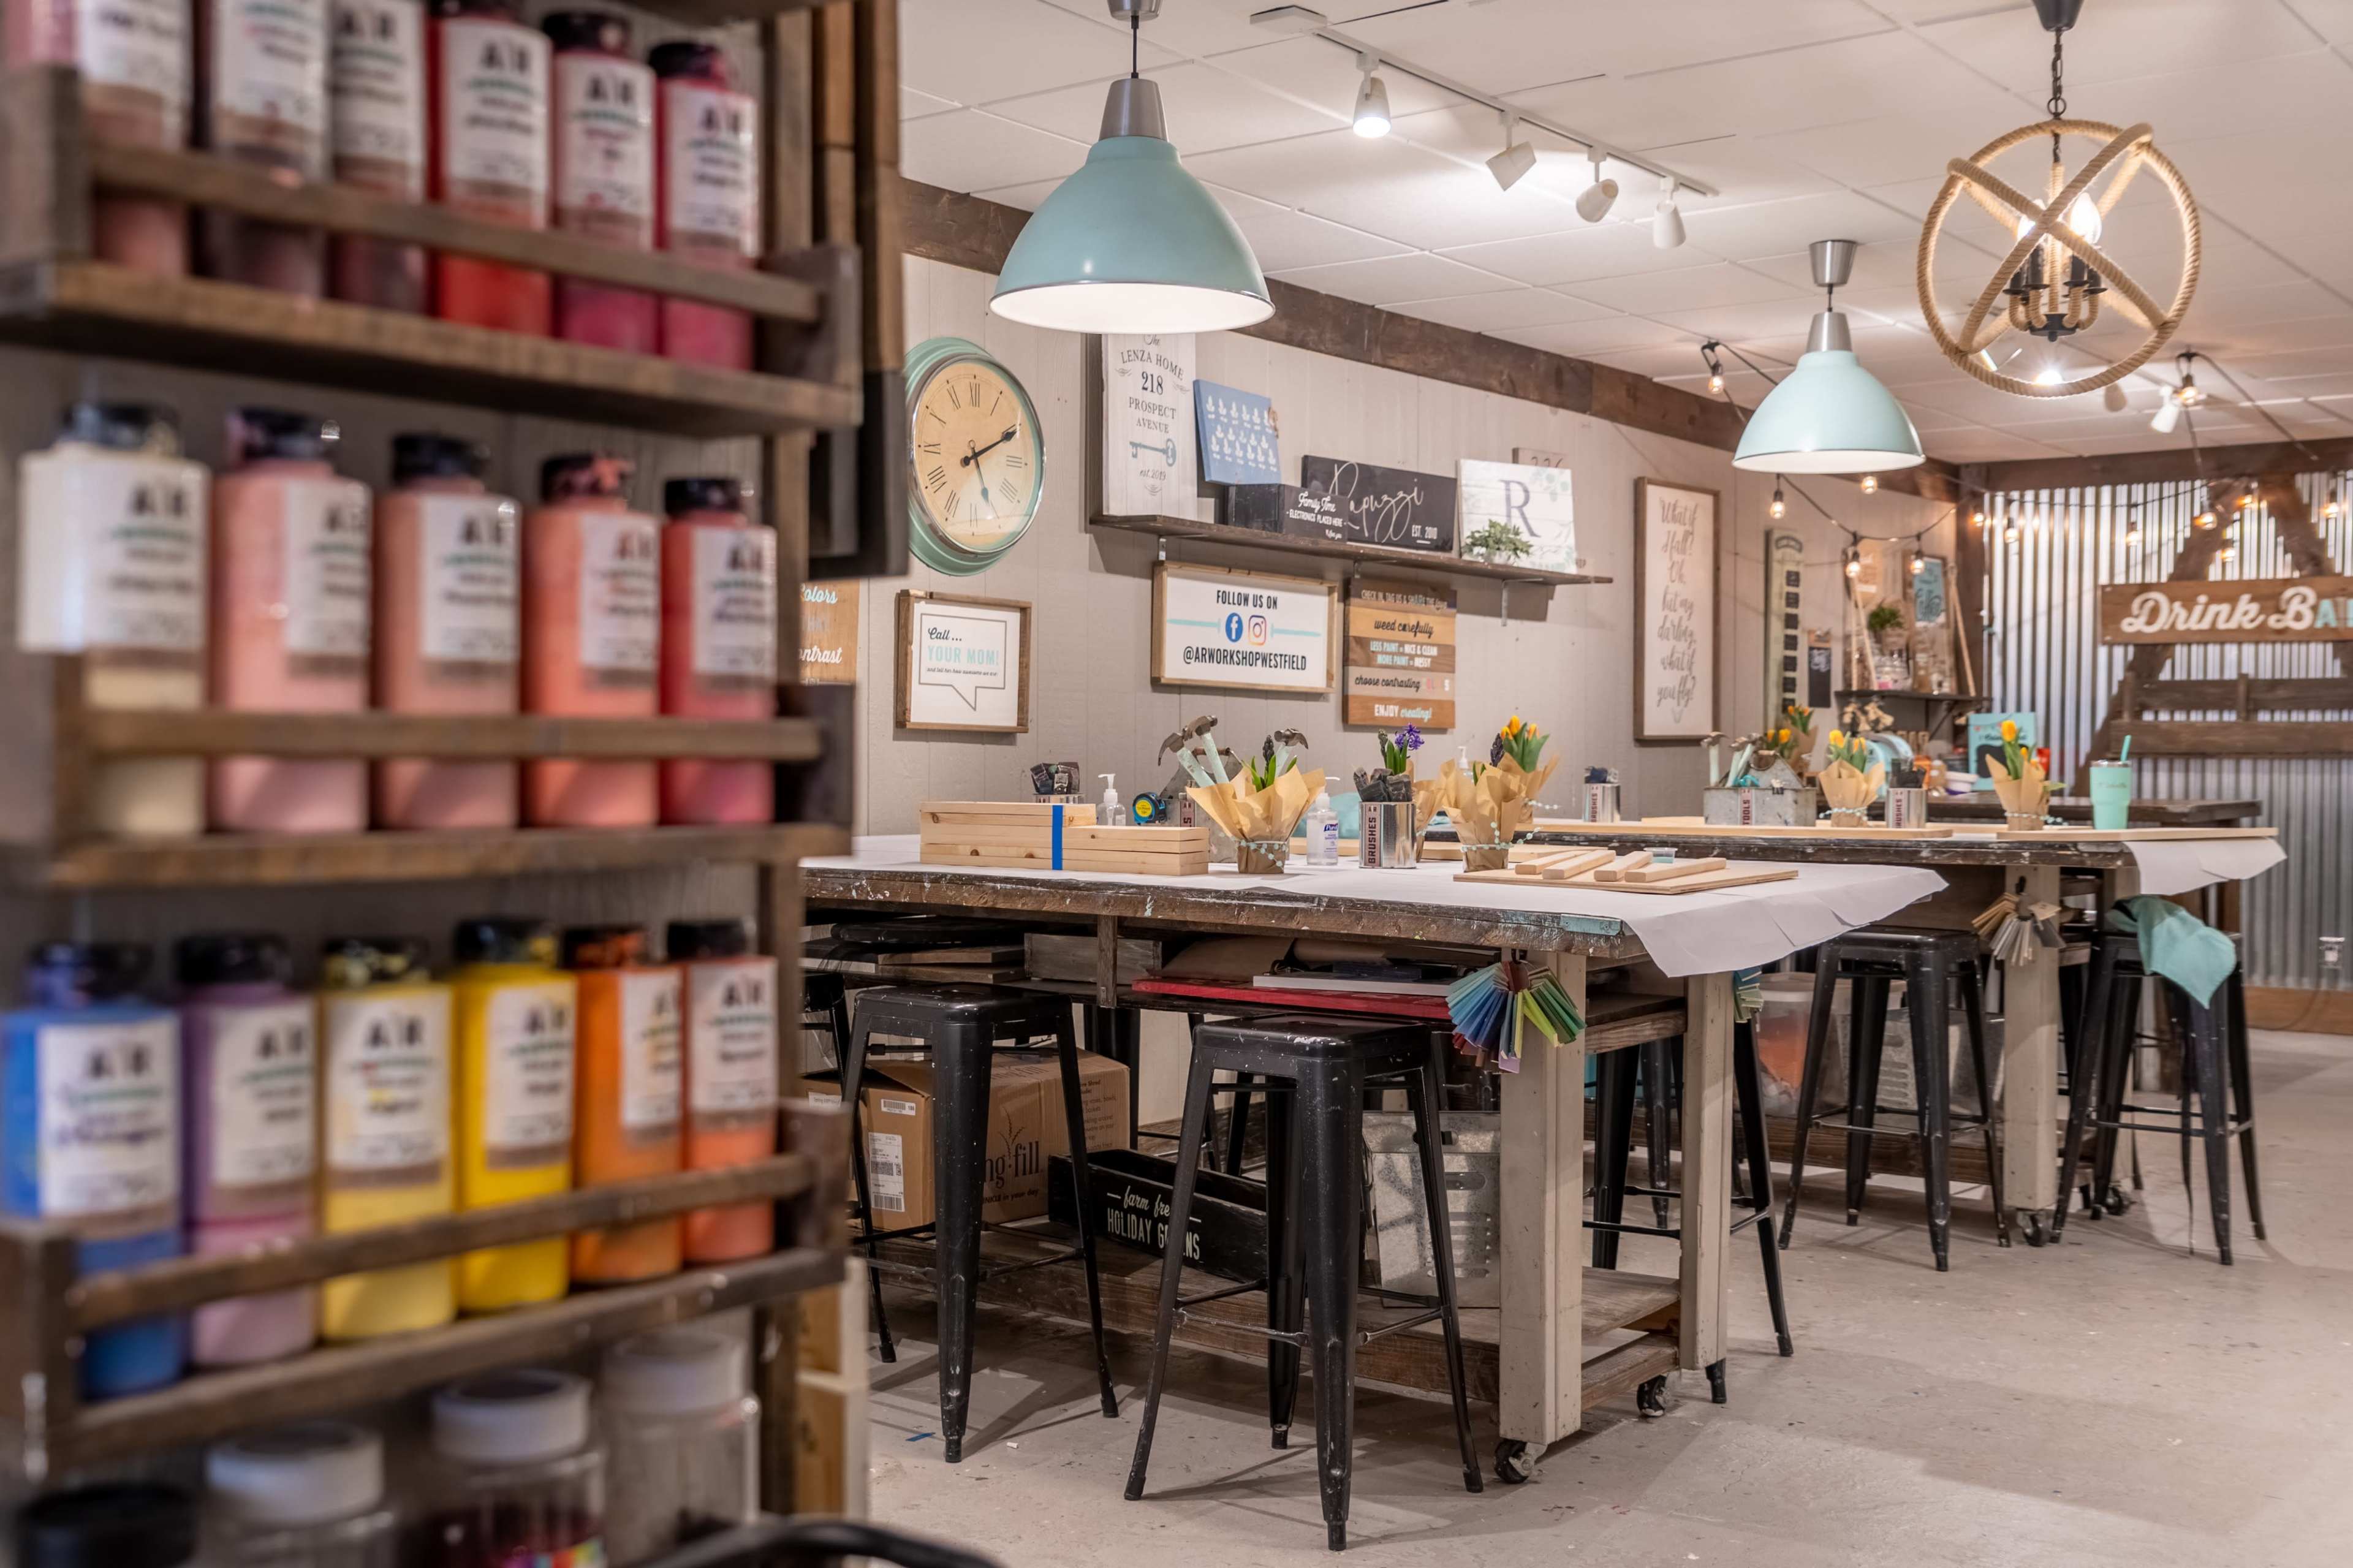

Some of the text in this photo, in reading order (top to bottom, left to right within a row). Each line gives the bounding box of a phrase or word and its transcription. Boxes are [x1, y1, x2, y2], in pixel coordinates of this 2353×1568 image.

[1121, 349, 1184, 381] LENZA HOME
[1142, 371, 1163, 395] 218
[1129, 396, 1176, 419] PROSPECT
[1136, 417, 1170, 434] AVENUE
[1298, 491, 1336, 513] Family Time
[1497, 479, 1542, 539] R
[1659, 497, 1688, 526] What
[1289, 509, 1343, 527] ELECTRONICS PLACED HERE
[1216, 589, 1278, 610] FOLLOW US ON
[1361, 589, 1376, 599] CHECK
[1385, 593, 1395, 603] TAG
[1395, 594, 1403, 604] US
[1661, 584, 1694, 621] but my
[2120, 590, 2267, 634] Drink
[928, 627, 950, 640] Call
[1374, 619, 1434, 639] weed carefully
[927, 645, 1000, 667] YOUR MOM!
[1183, 646, 1306, 670] @ARWORKSHOPWESTFIELD
[1370, 641, 1382, 651] LESS
[1383, 642, 1398, 653] PAINT
[1404, 643, 1416, 654] NICE
[1422, 645, 1438, 656] CLEAN
[1660, 645, 1685, 671] what
[1377, 654, 1392, 665] MORE
[1392, 655, 1408, 666] PAINT
[1414, 656, 1431, 667] MESSY
[1354, 675, 1380, 686] choose
[1381, 677, 1420, 692] contrasting
[1656, 674, 1696, 708] you fly?
[1374, 704, 1432, 722] ENJOY creating!
[1742, 799, 1751, 825] TOOLS
[1367, 817, 1377, 864] BRUSHES
[1123, 1185, 1170, 1218] farm fre
[1107, 1206, 1200, 1260] HOLIDAY GNS
